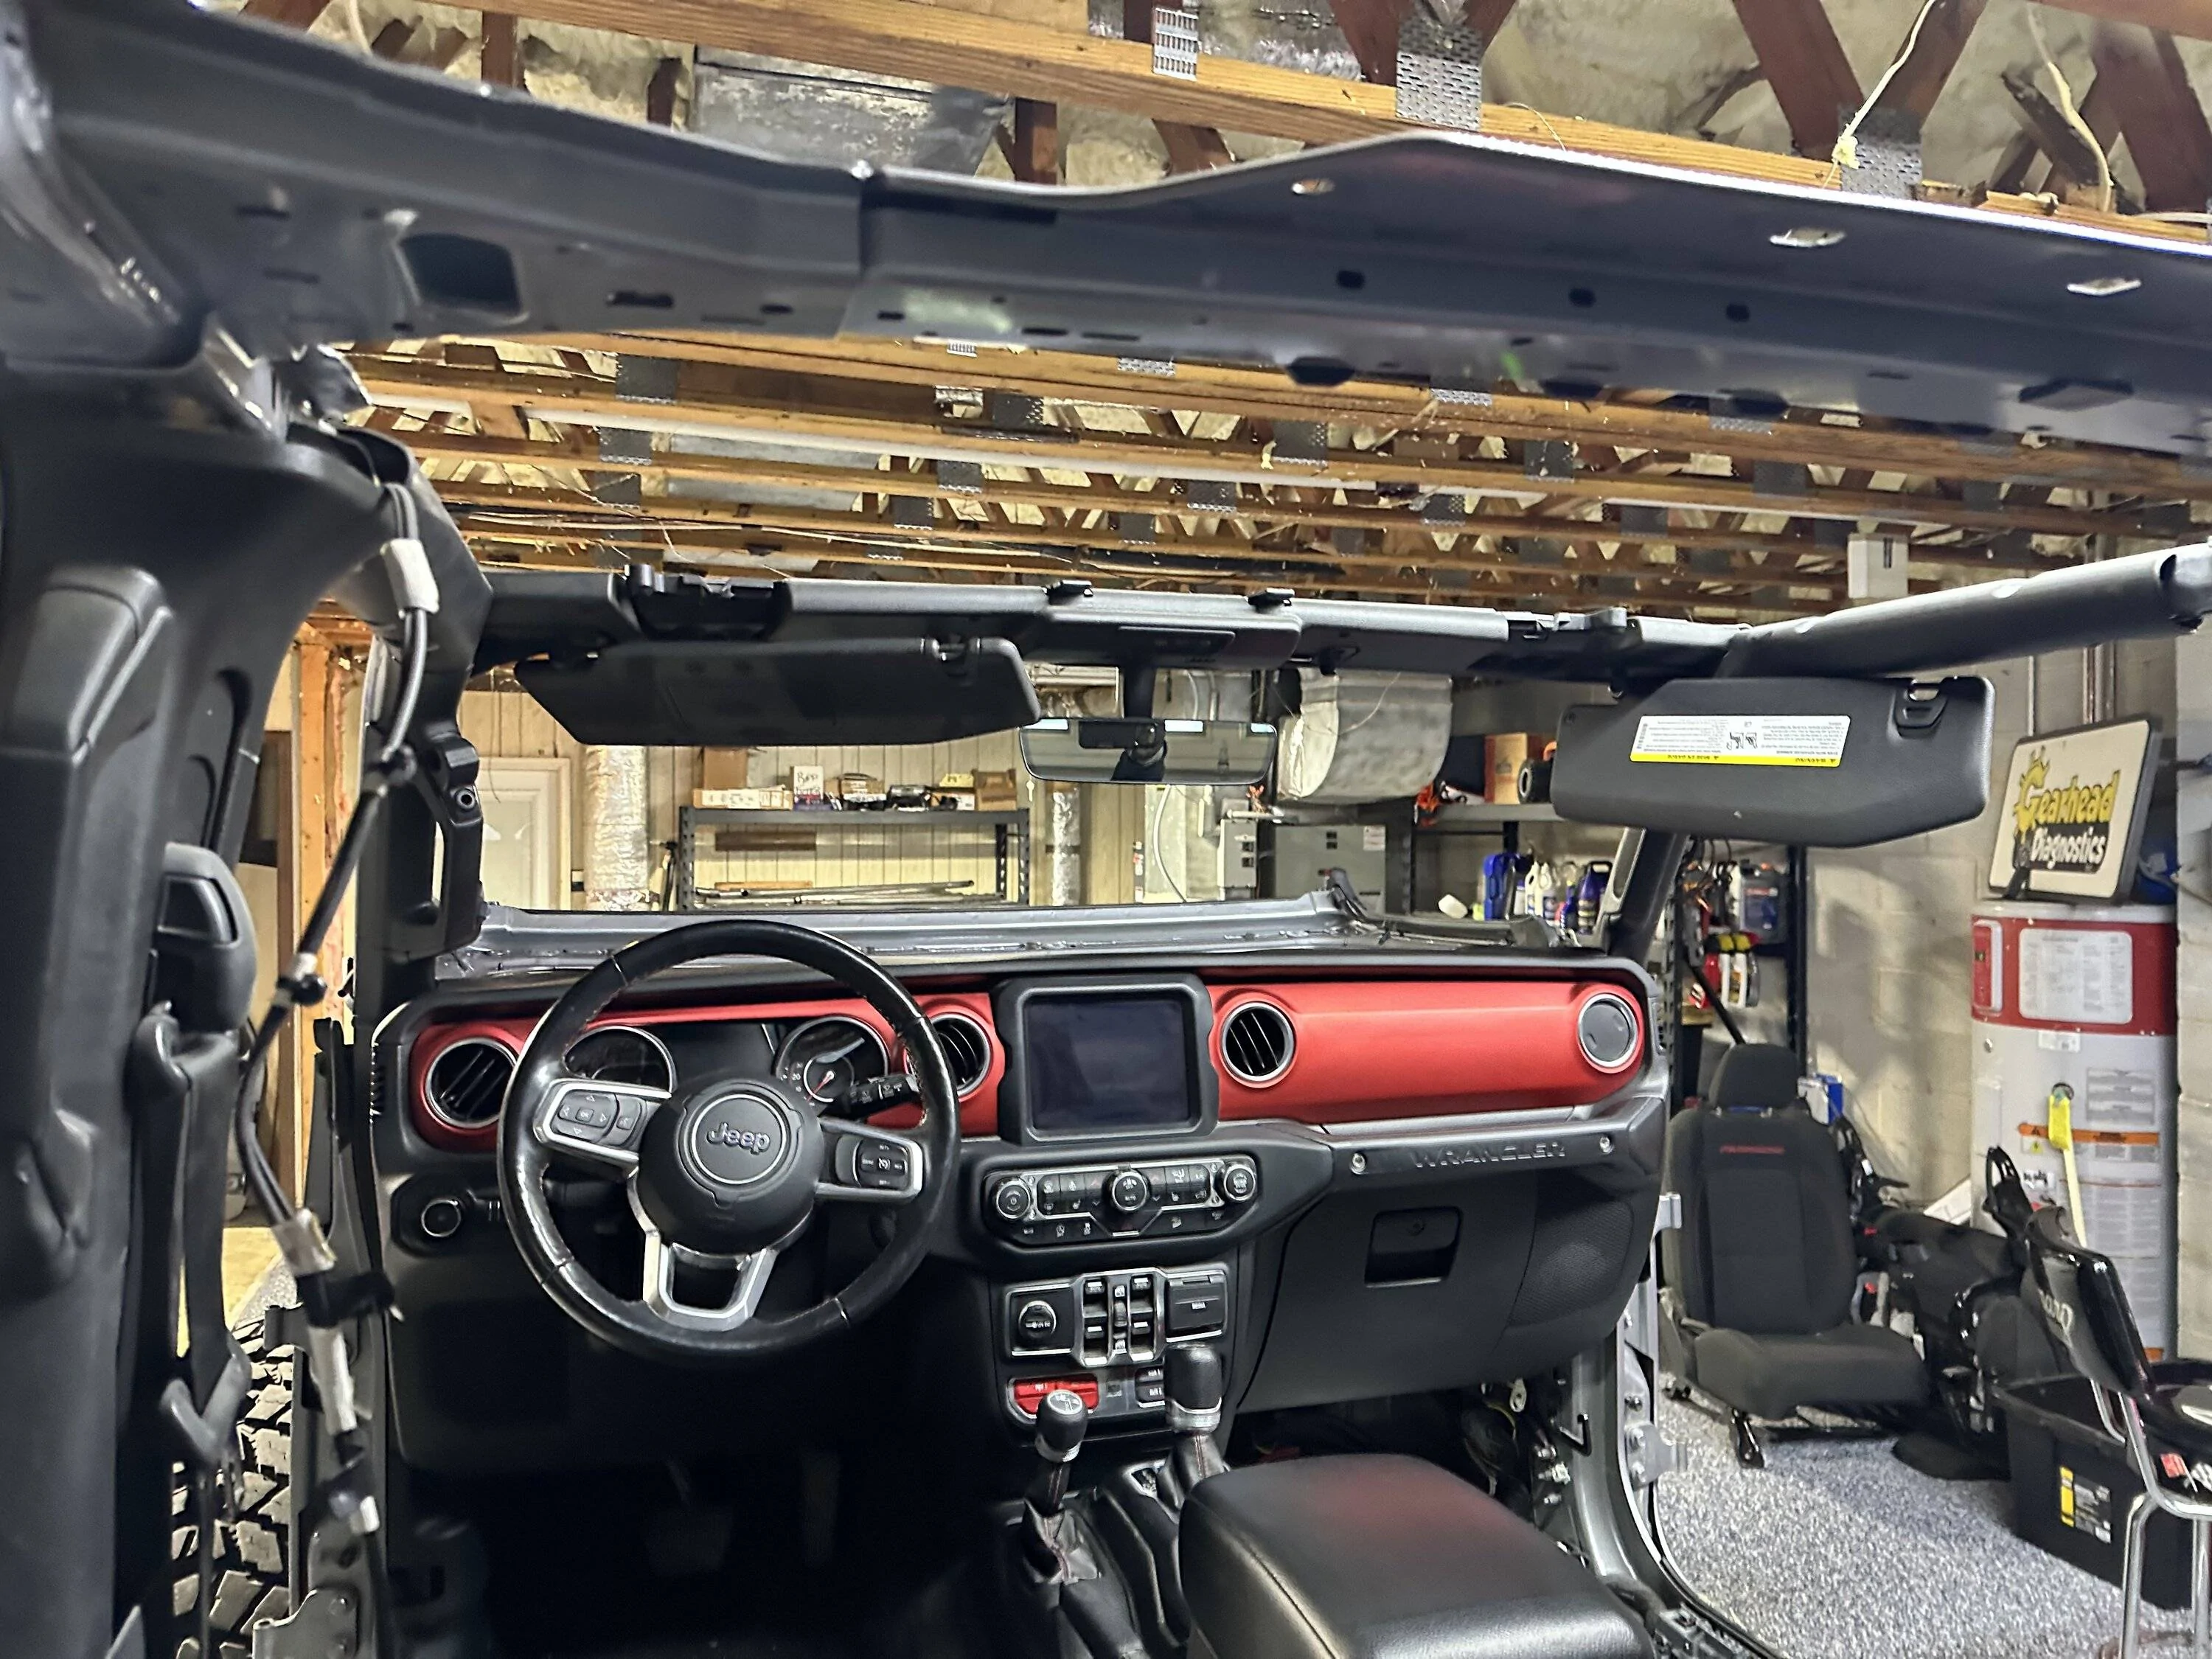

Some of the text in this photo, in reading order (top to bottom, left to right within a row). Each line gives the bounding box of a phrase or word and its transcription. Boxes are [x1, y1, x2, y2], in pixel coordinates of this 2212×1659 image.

[2014, 764, 2121, 824] Gearhead
[2030, 826, 2107, 869] Diagnostics
[706, 1121, 771, 1155] Jeep
[1410, 1141, 1566, 1169] WRANGLER
